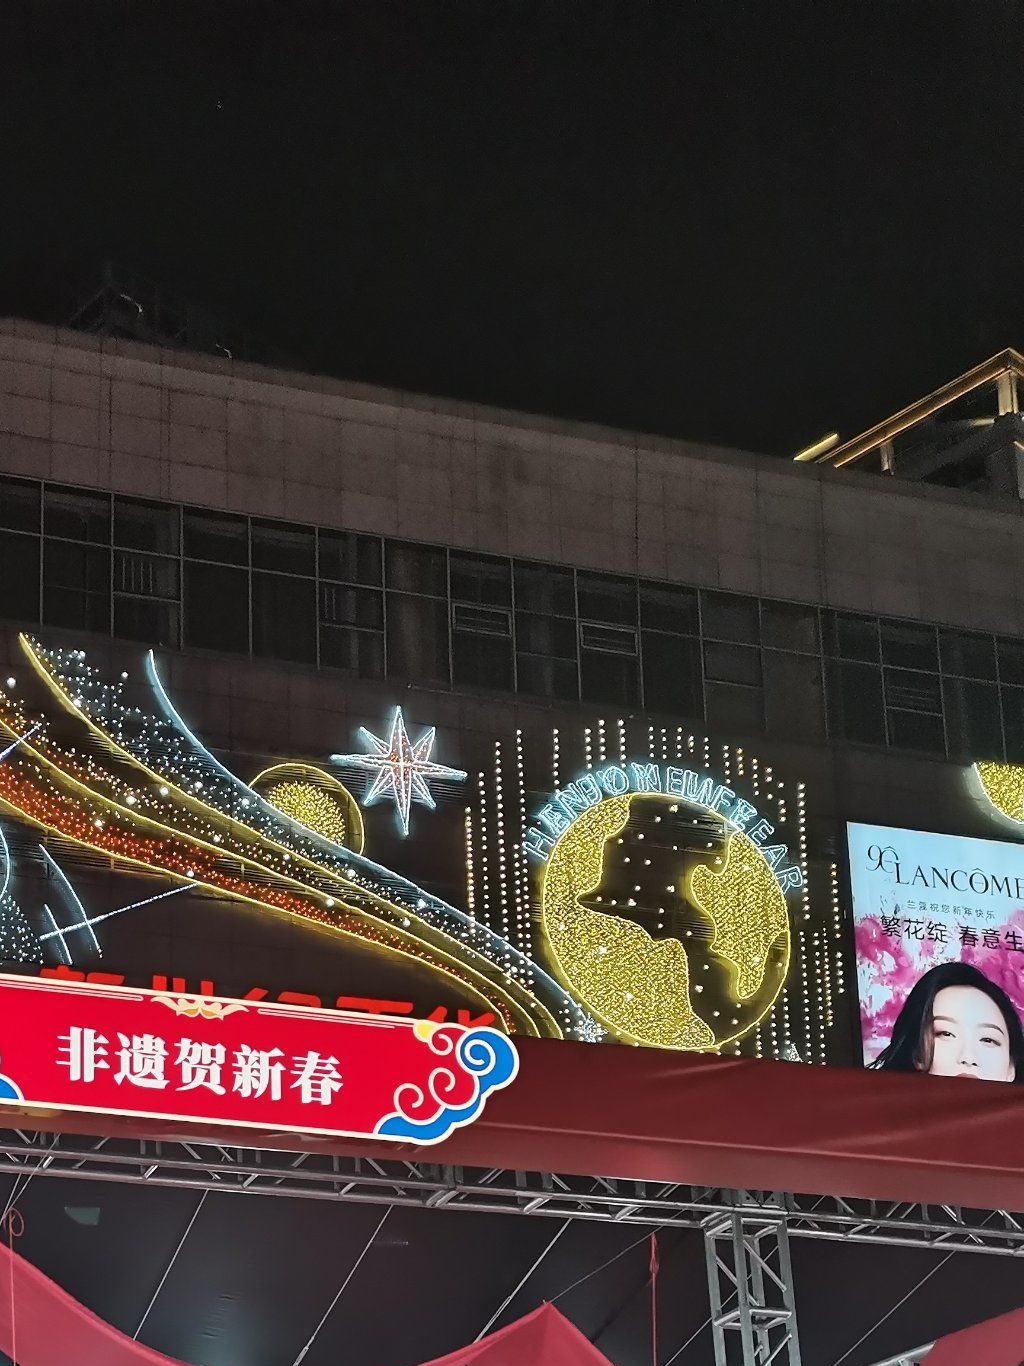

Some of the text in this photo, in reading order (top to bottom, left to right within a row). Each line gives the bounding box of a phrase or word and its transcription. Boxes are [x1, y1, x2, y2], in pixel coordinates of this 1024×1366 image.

[880, 914, 949, 944] 繁花绽
[55, 1026, 344, 1105] 非遗贺新春
